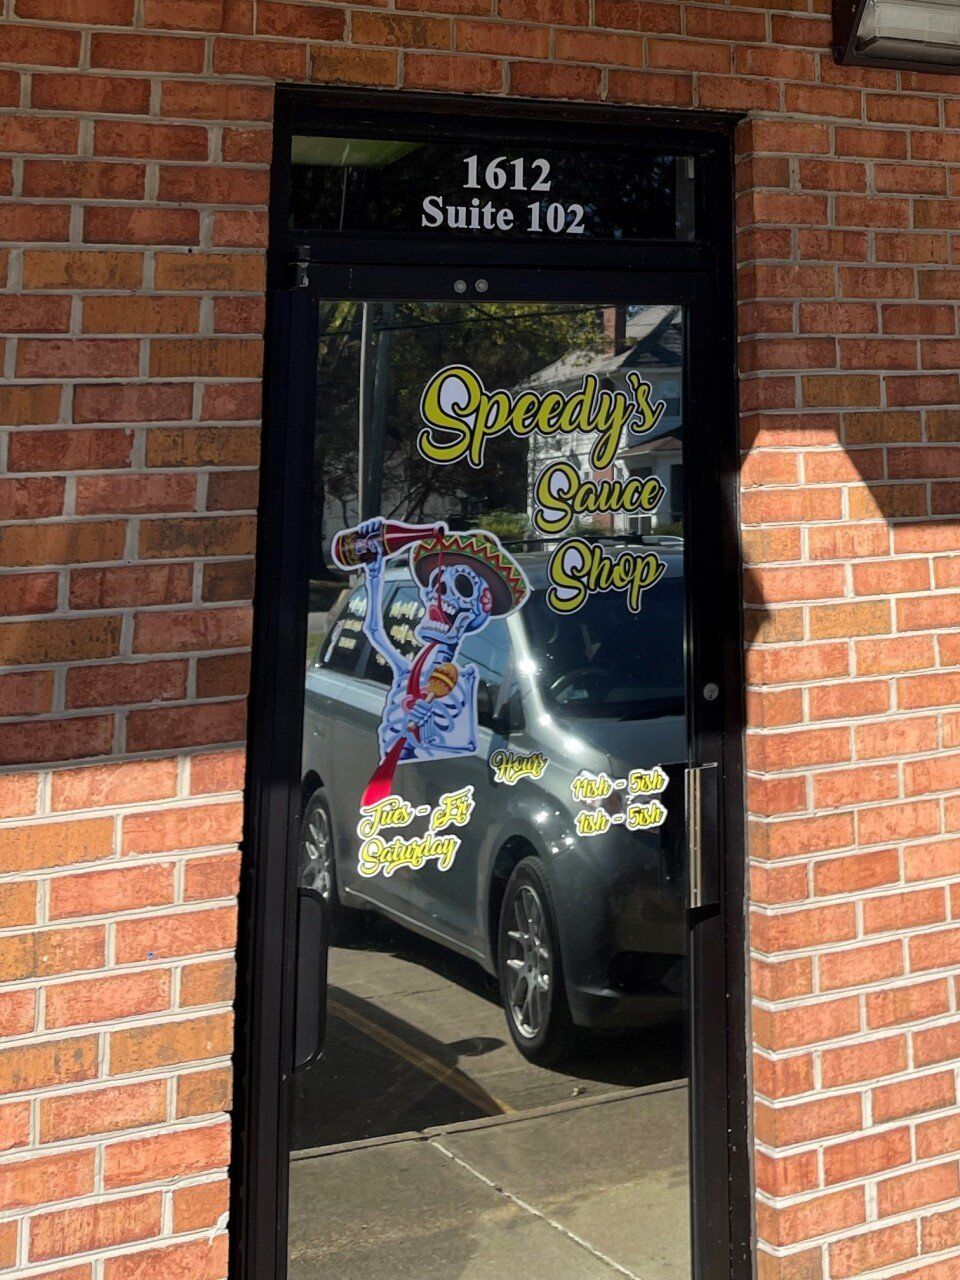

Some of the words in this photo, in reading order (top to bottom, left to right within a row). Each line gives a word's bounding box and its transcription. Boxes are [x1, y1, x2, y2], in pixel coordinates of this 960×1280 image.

[462, 154, 552, 192] 1612
[421, 195, 514, 231] Suite
[526, 201, 585, 234] 102
[417, 364, 666, 470] Speedy's
[533, 461, 665, 534] Sauce
[546, 537, 667, 613] Shop
[489, 751, 549, 785] Hours
[570, 772, 613, 801] 11ish
[628, 766, 669, 796] 5ish
[357, 795, 415, 840] Tues
[415, 804, 431, 817] -
[429, 785, 476, 833] Fri
[574, 807, 611, 836] 1ish
[626, 799, 668, 831] 5ish
[358, 834, 461, 878] Saturday
